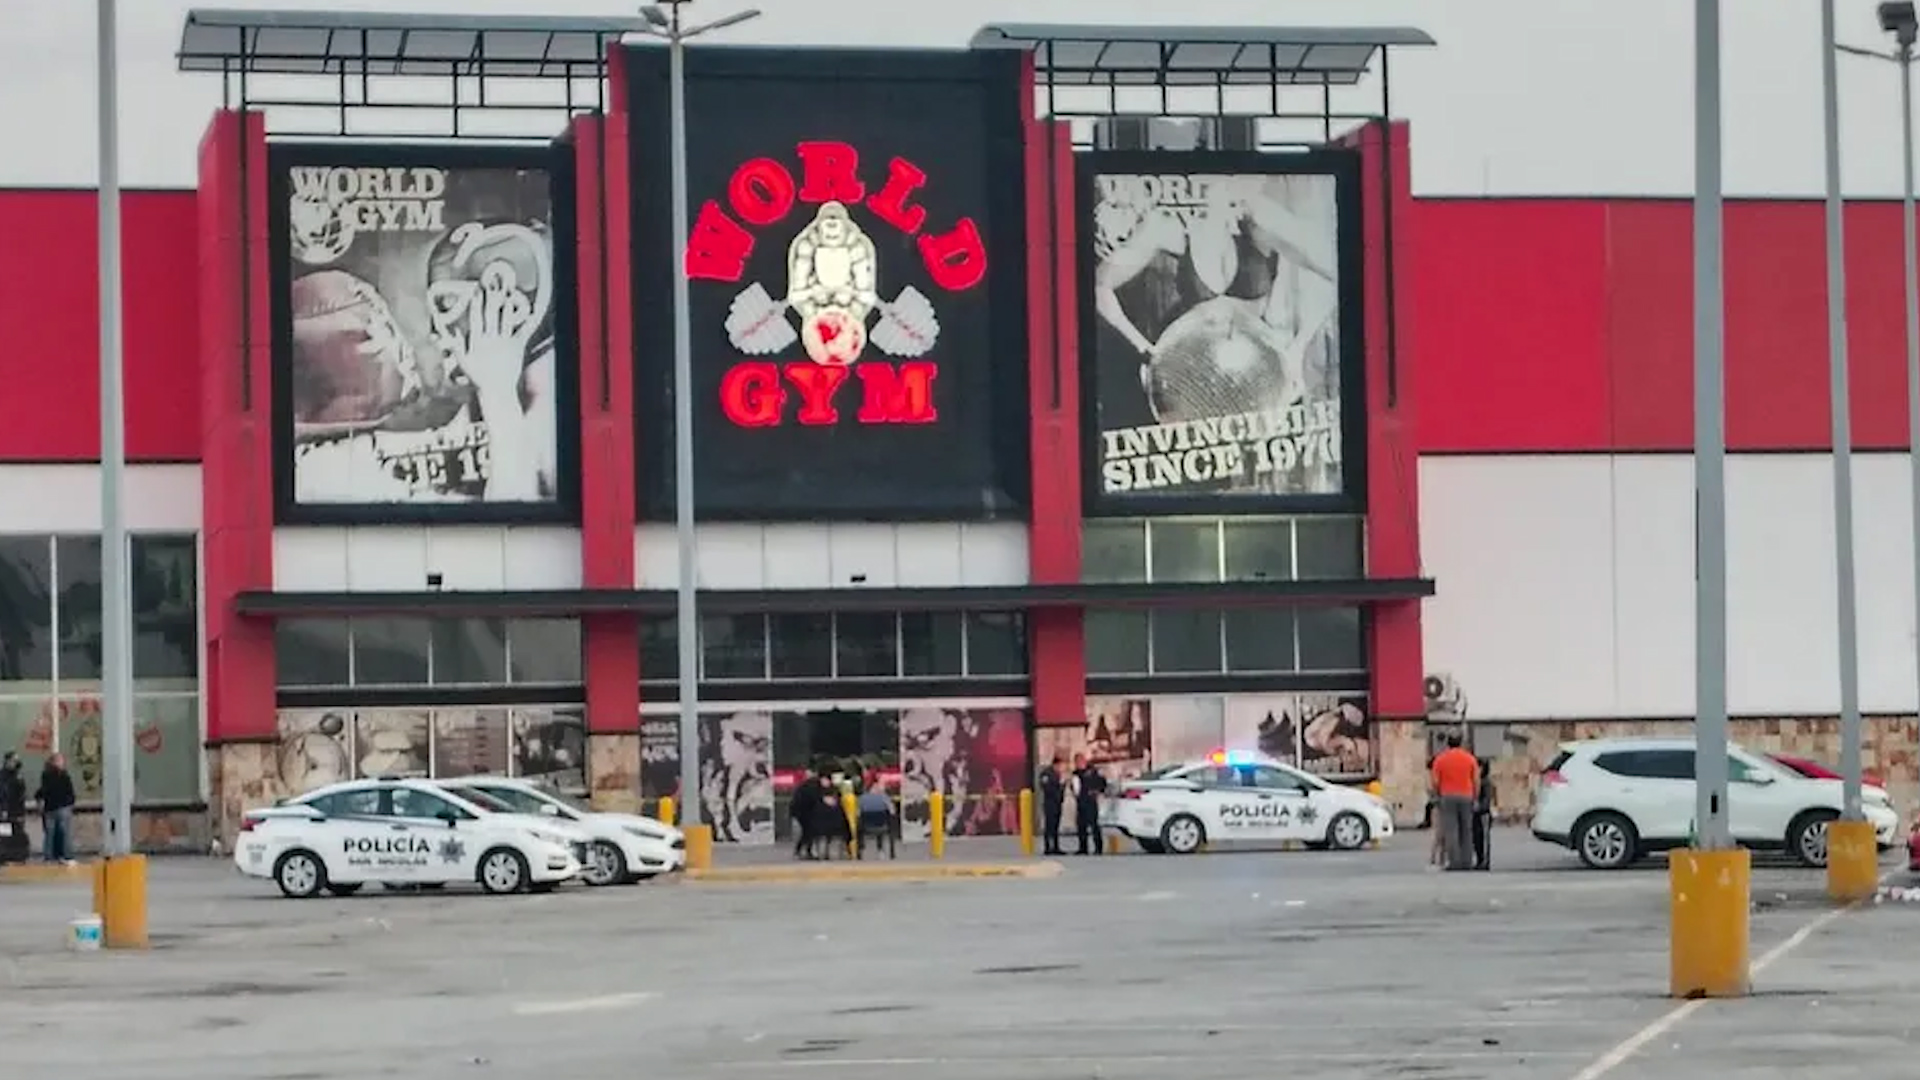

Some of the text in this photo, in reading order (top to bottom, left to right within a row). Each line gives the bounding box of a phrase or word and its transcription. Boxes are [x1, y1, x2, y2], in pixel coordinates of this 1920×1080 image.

[289, 166, 446, 201] WORLD
[351, 199, 446, 231] GYM
[684, 141, 988, 290] WORLD
[720, 362, 938, 426] GYM
[1102, 442, 1244, 493] SINCE
[1219, 802, 1291, 818] POLICÍA
[343, 833, 431, 853] POLICÍA
